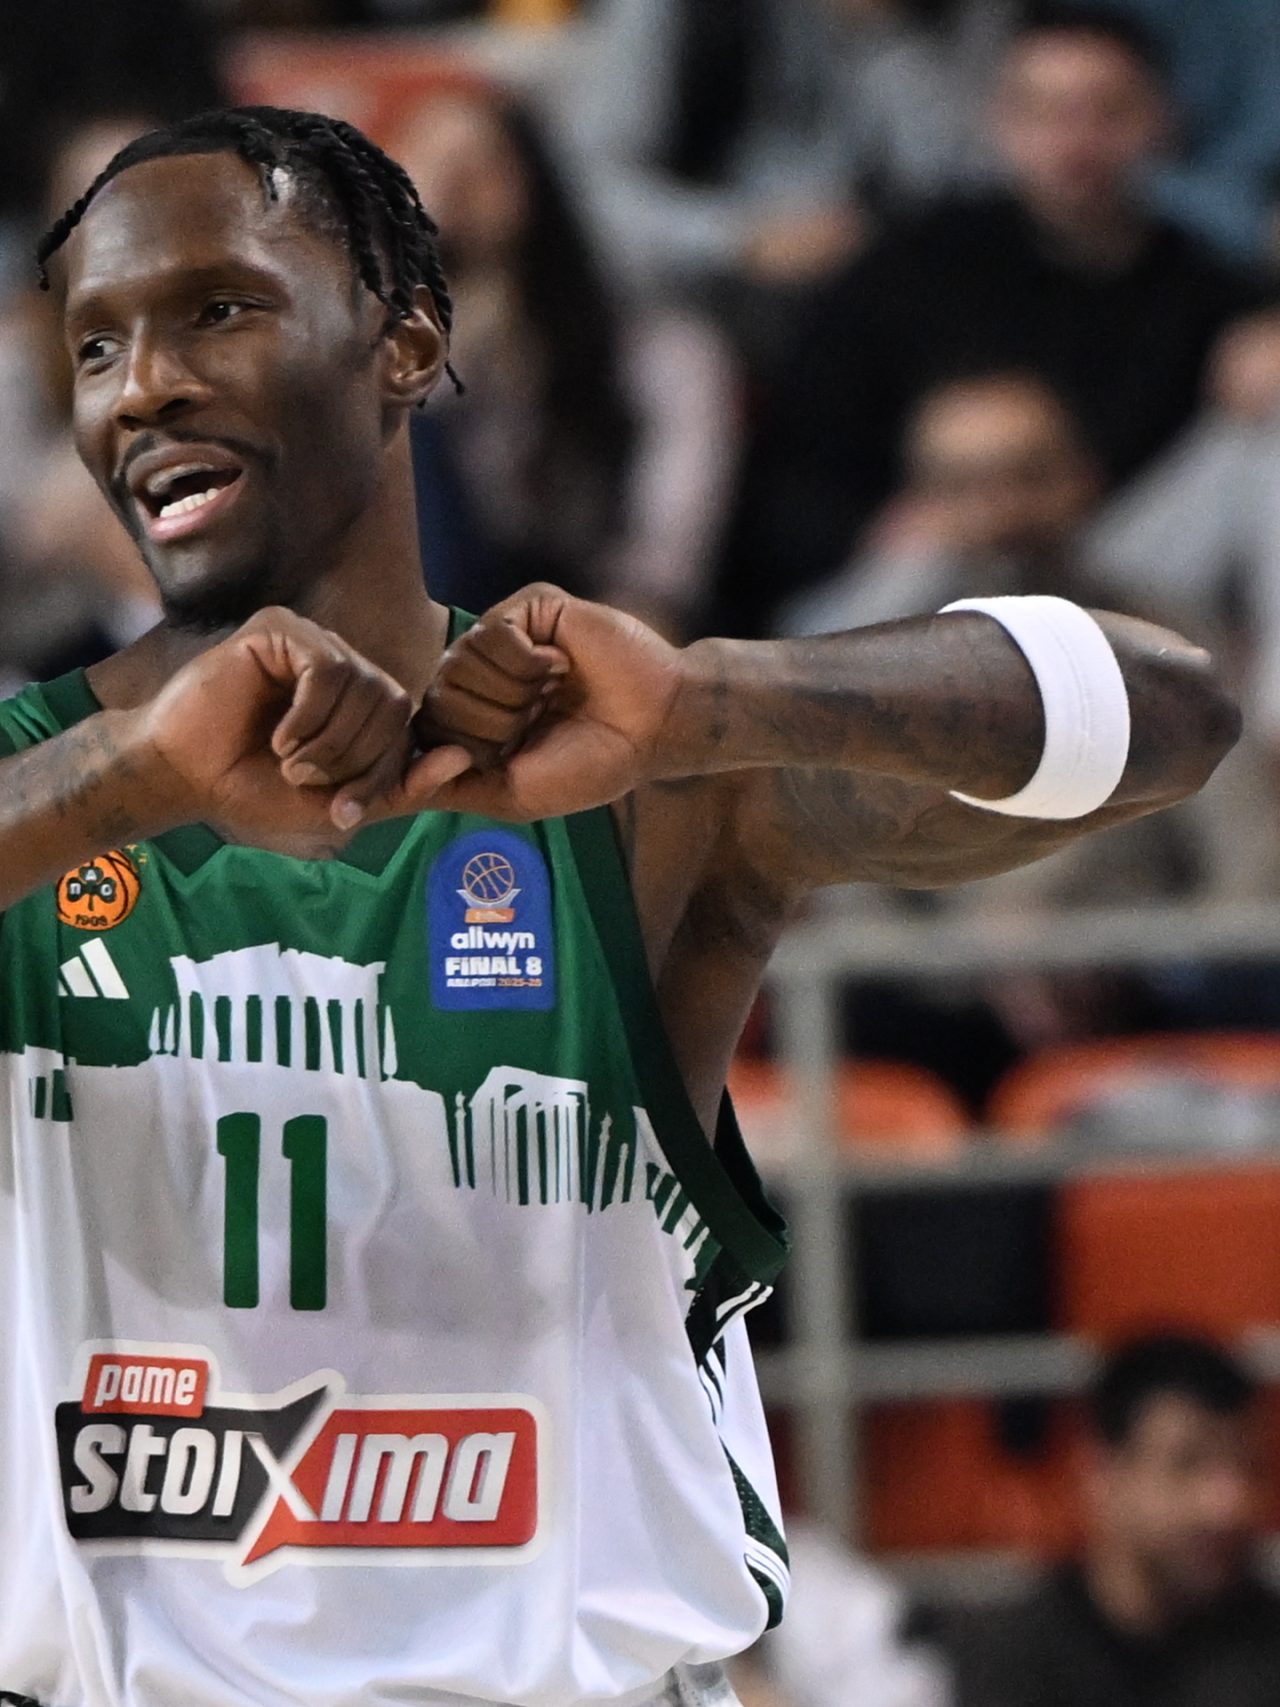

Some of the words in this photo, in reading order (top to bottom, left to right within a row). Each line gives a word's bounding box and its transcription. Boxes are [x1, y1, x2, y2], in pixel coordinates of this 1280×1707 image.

[450, 926, 535, 955] allwyn
[445, 956, 522, 976] FINAL
[525, 957, 542, 976] 8
[217, 1111, 327, 1311] 11
[94, 1363, 198, 1408] pame
